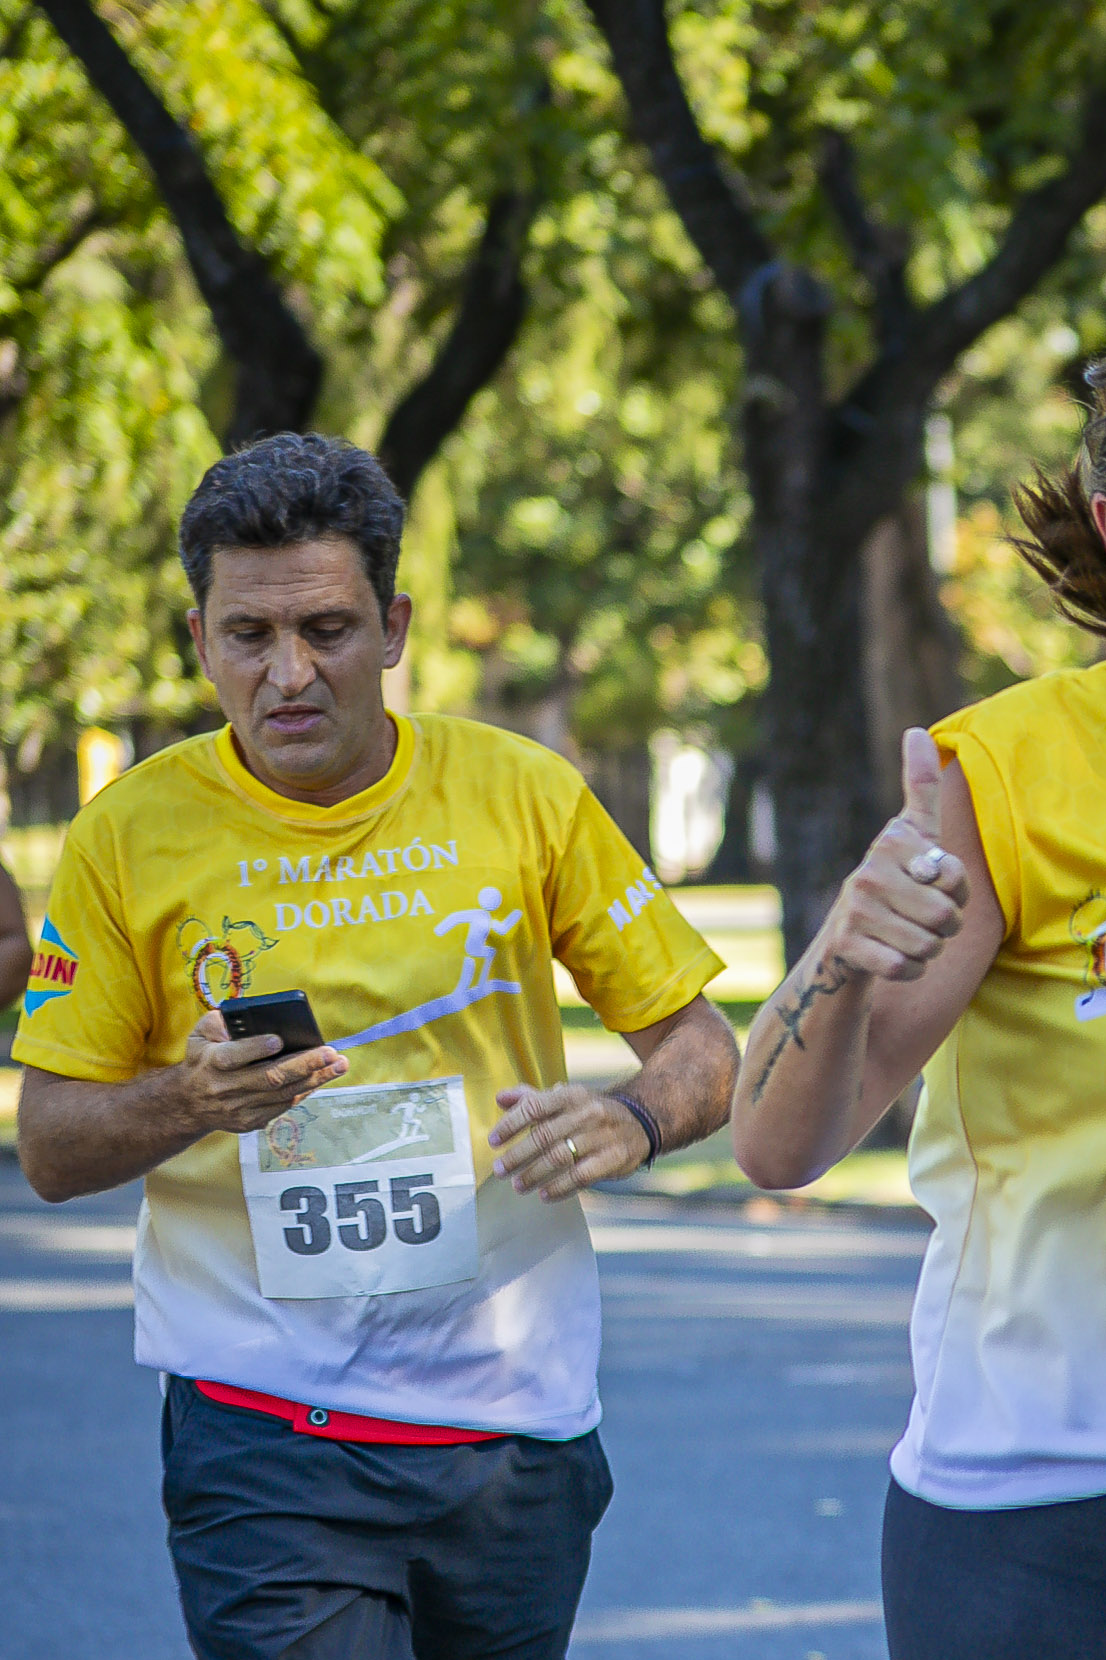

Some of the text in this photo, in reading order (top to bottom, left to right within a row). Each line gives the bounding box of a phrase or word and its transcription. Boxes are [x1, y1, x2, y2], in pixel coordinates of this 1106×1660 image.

[277, 836, 459, 885] MARATÓN
[273, 889, 436, 932] DORADA
[280, 1173, 442, 1256] 355
